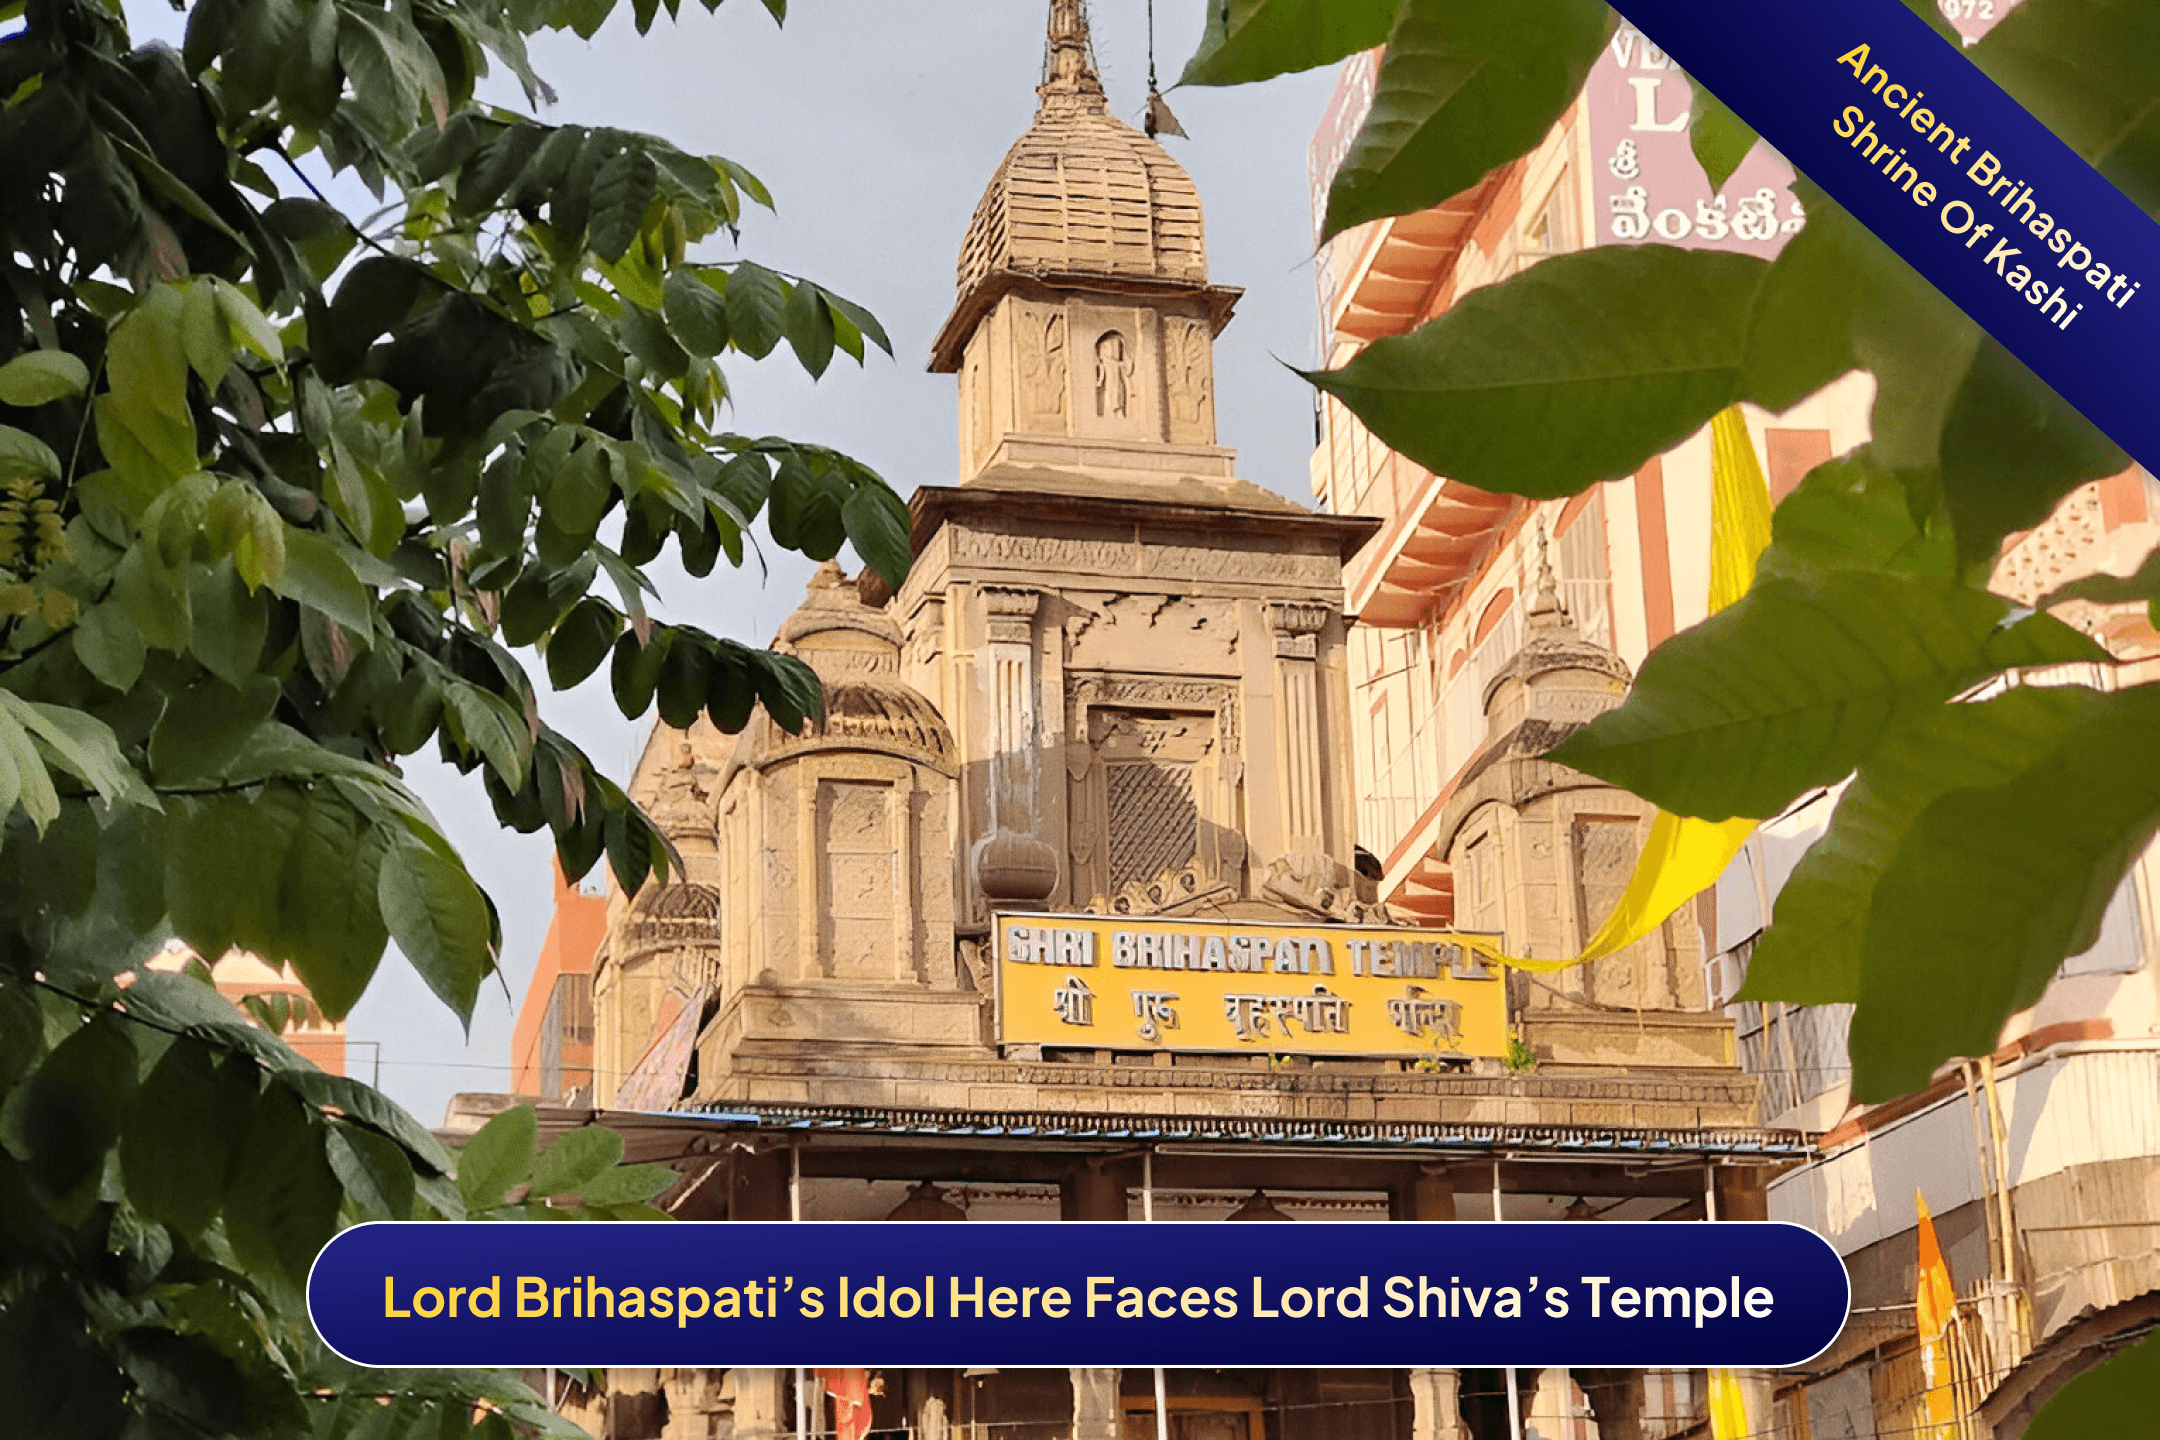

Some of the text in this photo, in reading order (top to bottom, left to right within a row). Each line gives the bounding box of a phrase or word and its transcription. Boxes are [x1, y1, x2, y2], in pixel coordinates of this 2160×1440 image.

[1628, 77, 1690, 132] L
[1008, 926, 1096, 967] SHRI
[1112, 931, 1335, 976] BRIHASPATI
[1053, 974, 1096, 1027] श्री
